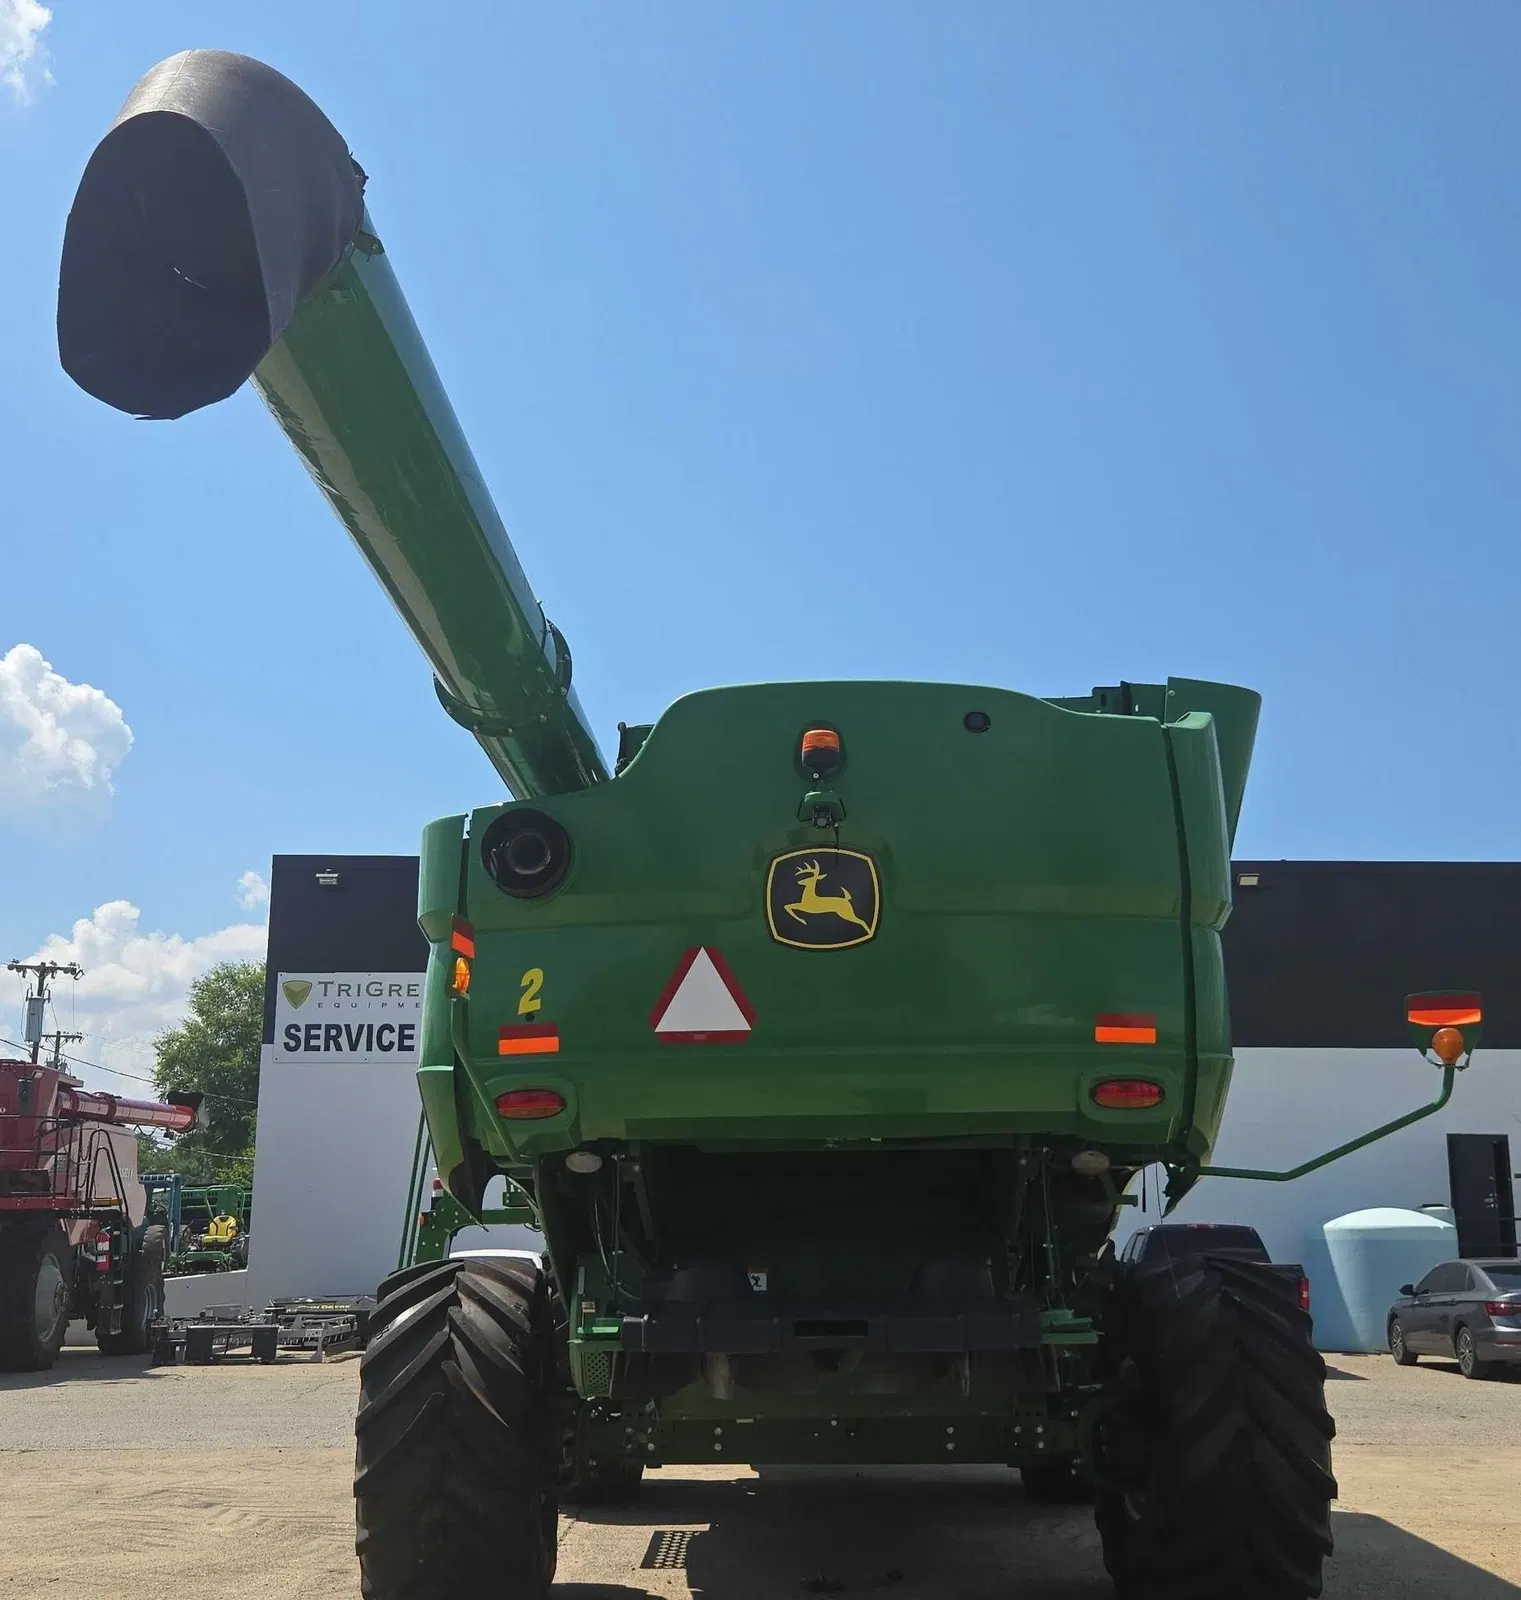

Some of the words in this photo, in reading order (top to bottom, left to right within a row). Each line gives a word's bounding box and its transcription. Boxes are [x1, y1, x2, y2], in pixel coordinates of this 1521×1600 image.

[317, 980, 420, 998] TRIGRE
[518, 967, 544, 1015] 2
[283, 1023, 416, 1052] SERVICE
